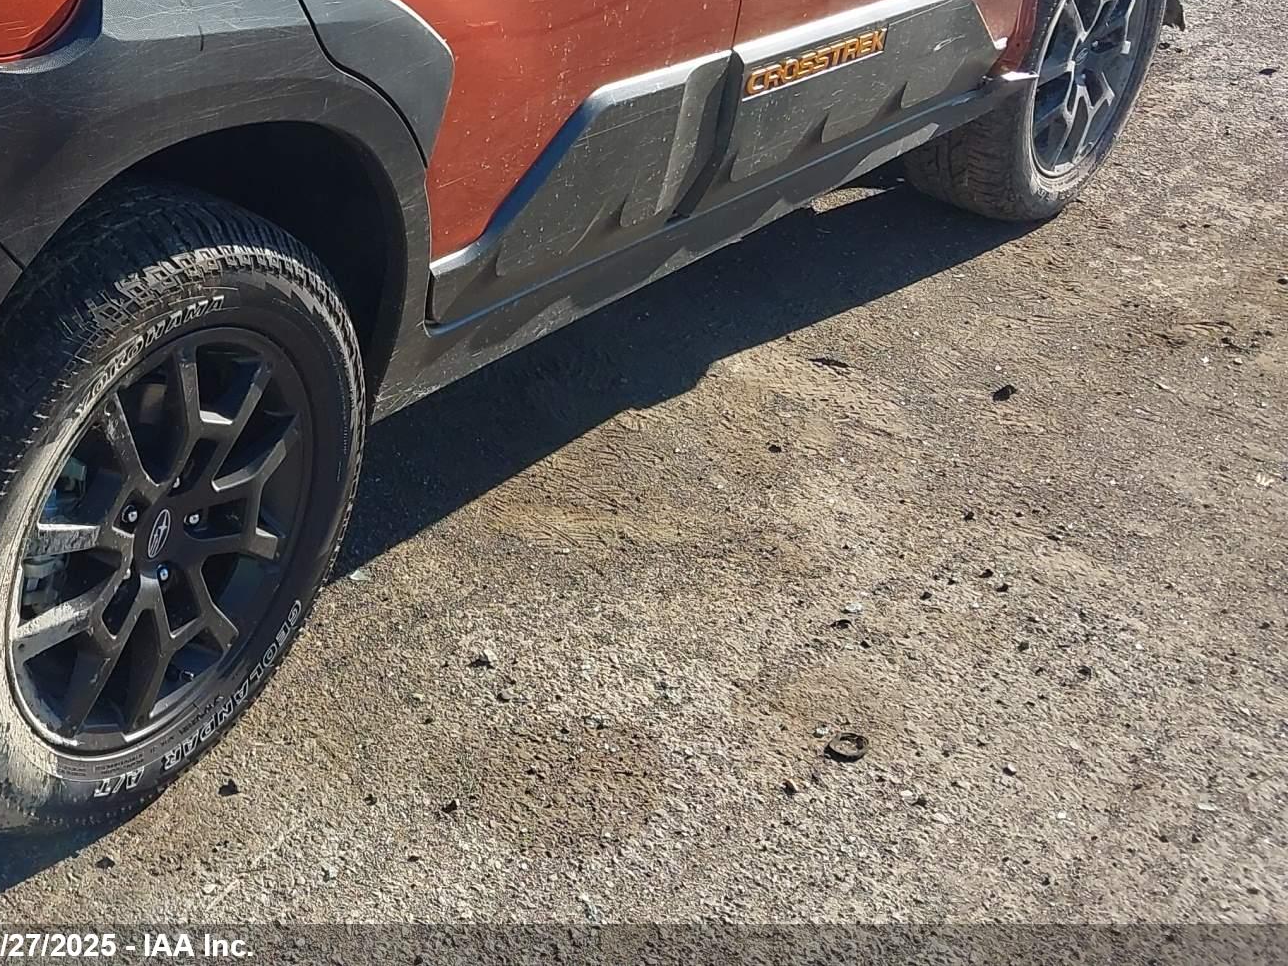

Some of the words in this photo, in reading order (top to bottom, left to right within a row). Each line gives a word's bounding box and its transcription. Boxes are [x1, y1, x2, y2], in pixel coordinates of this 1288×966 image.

[744, 26, 889, 96] CROSSTREK
[74, 295, 225, 416] YOKOHAMA
[163, 599, 302, 772] GEOLANDAR
[93, 766, 145, 798] A/T
